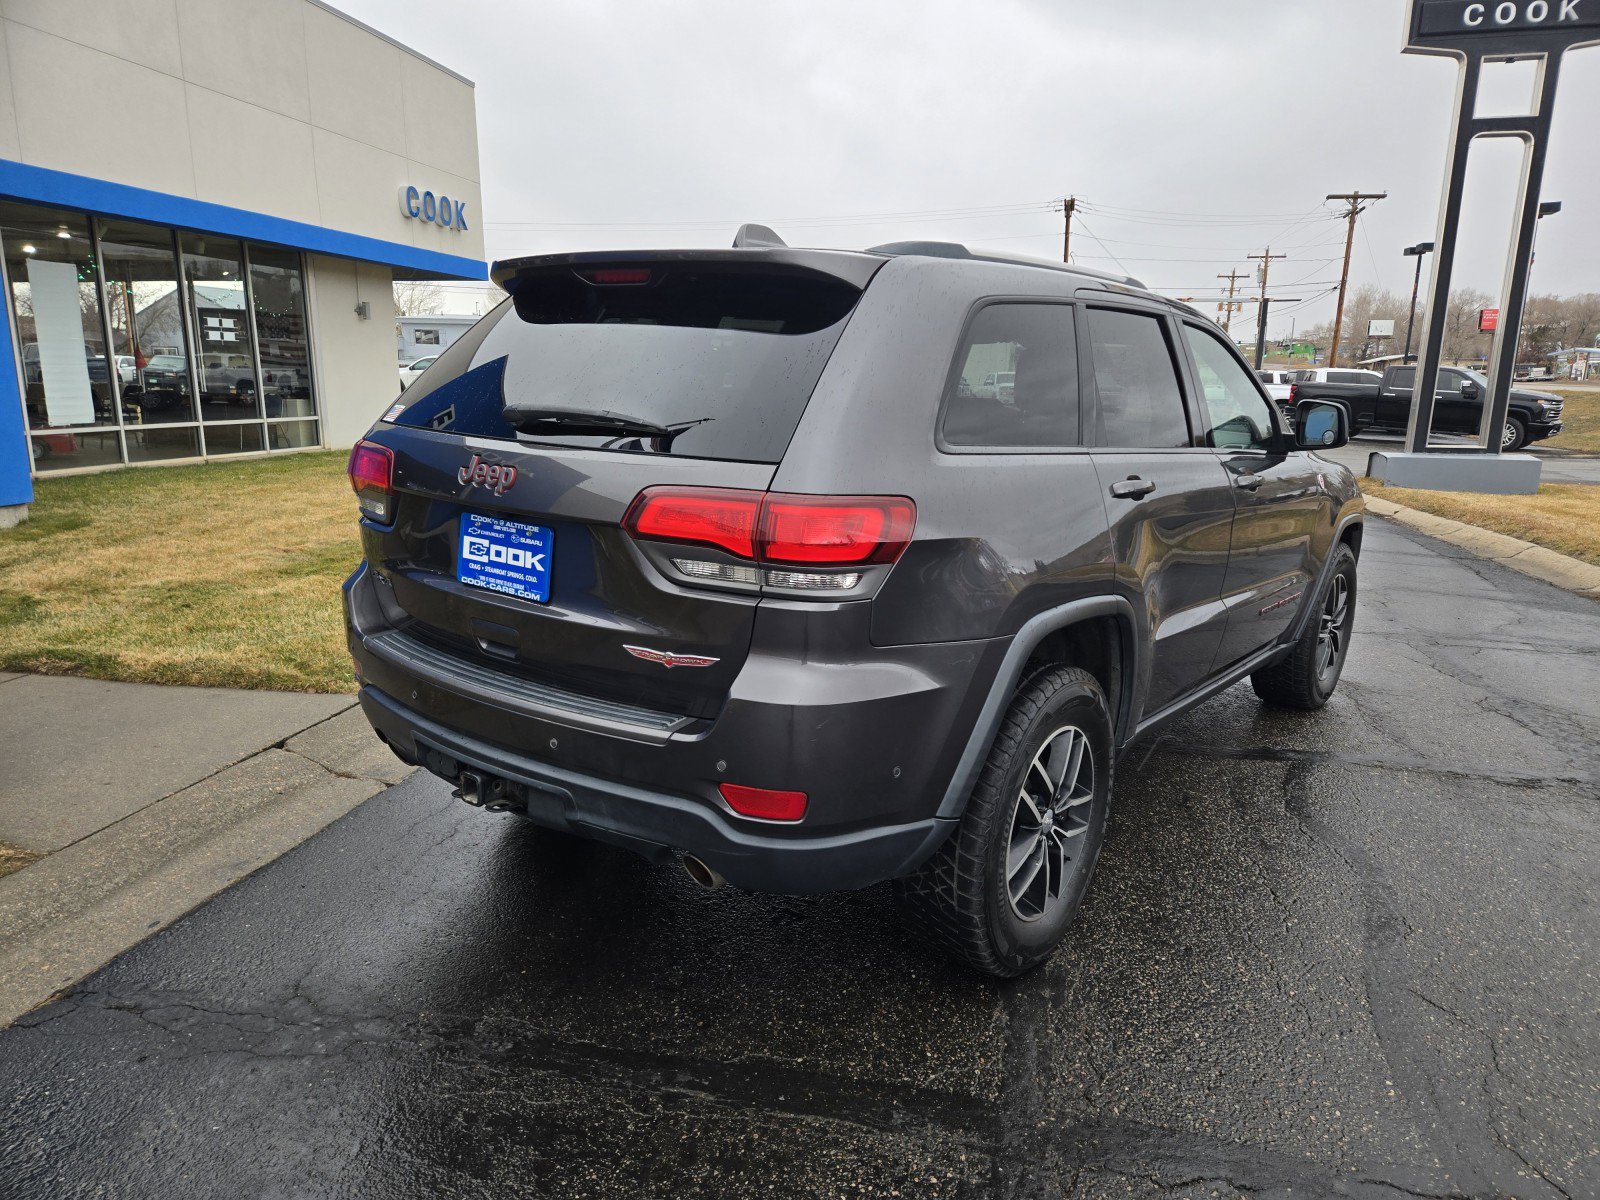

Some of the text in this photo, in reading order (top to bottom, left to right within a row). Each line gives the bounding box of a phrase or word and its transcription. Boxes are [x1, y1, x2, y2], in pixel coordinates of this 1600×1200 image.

[1463, 0, 1579, 26] COOK
[405, 185, 468, 231] COOK
[457, 455, 517, 497] Jeep
[506, 522, 539, 532] ALTITUDE
[463, 536, 545, 571] COOK
[520, 538, 542, 546] SUBARU
[485, 566, 506, 575] STEAMBOAT
[461, 576, 540, 600] COOK-CARS.COM
